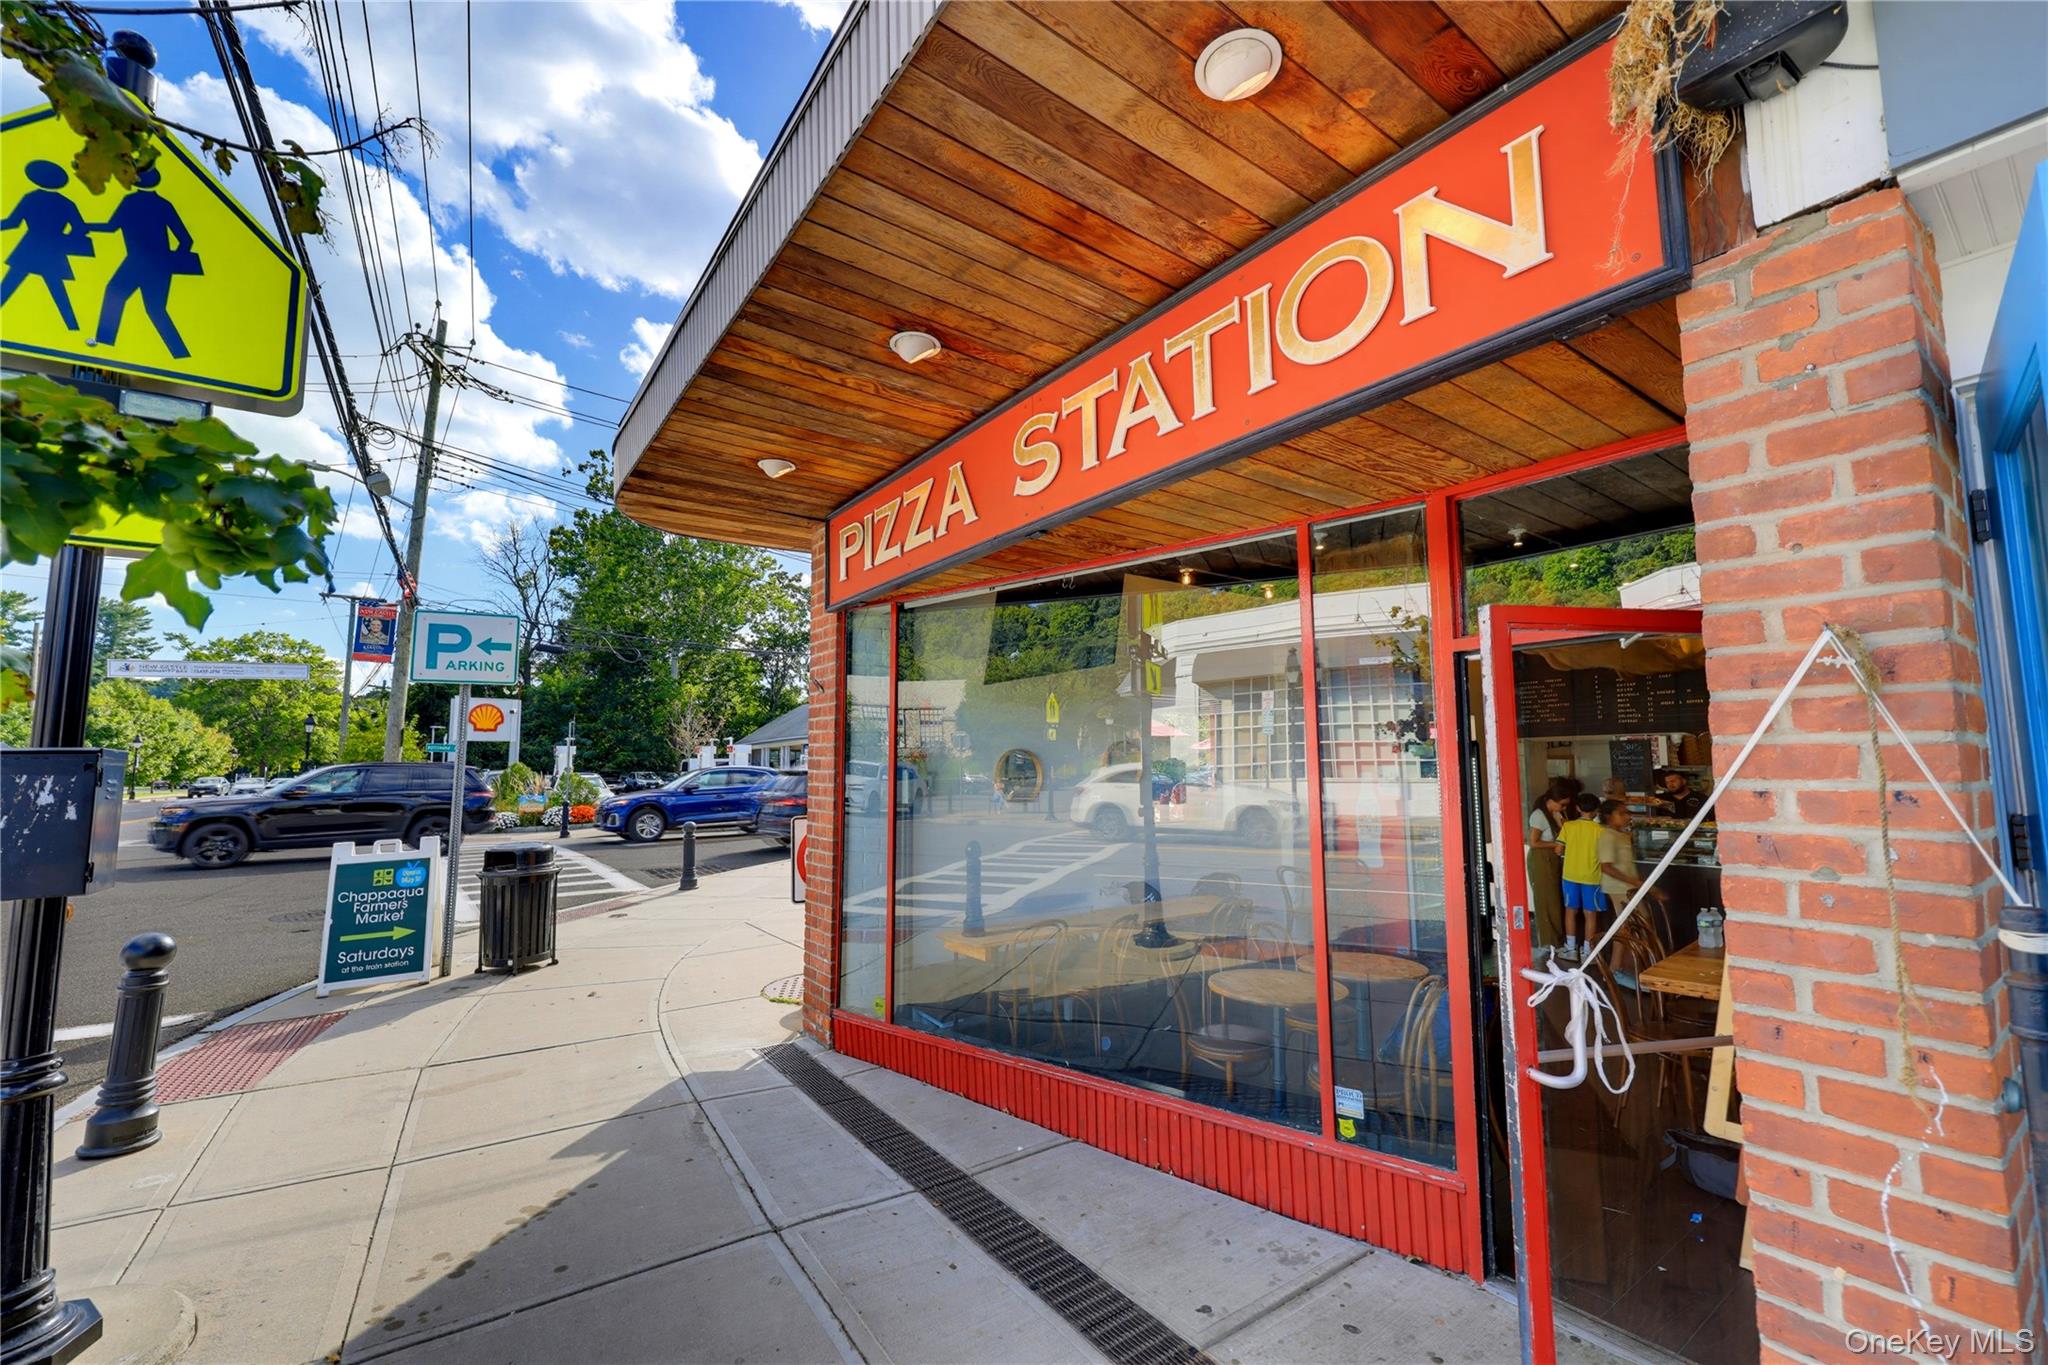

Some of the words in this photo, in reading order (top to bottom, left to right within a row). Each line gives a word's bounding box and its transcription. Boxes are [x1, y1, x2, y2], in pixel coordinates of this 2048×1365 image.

[839, 461, 979, 582] PIZZA
[1013, 124, 1554, 497] STATION
[337, 887, 425, 903] Chappaqua
[353, 899, 409, 913] Farmers
[355, 909, 405, 925] Market
[337, 945, 415, 964] Saturdays
[341, 966, 350, 974] at
[351, 963, 364, 973] the
[365, 962, 383, 971] train
[384, 960, 409, 969] station
